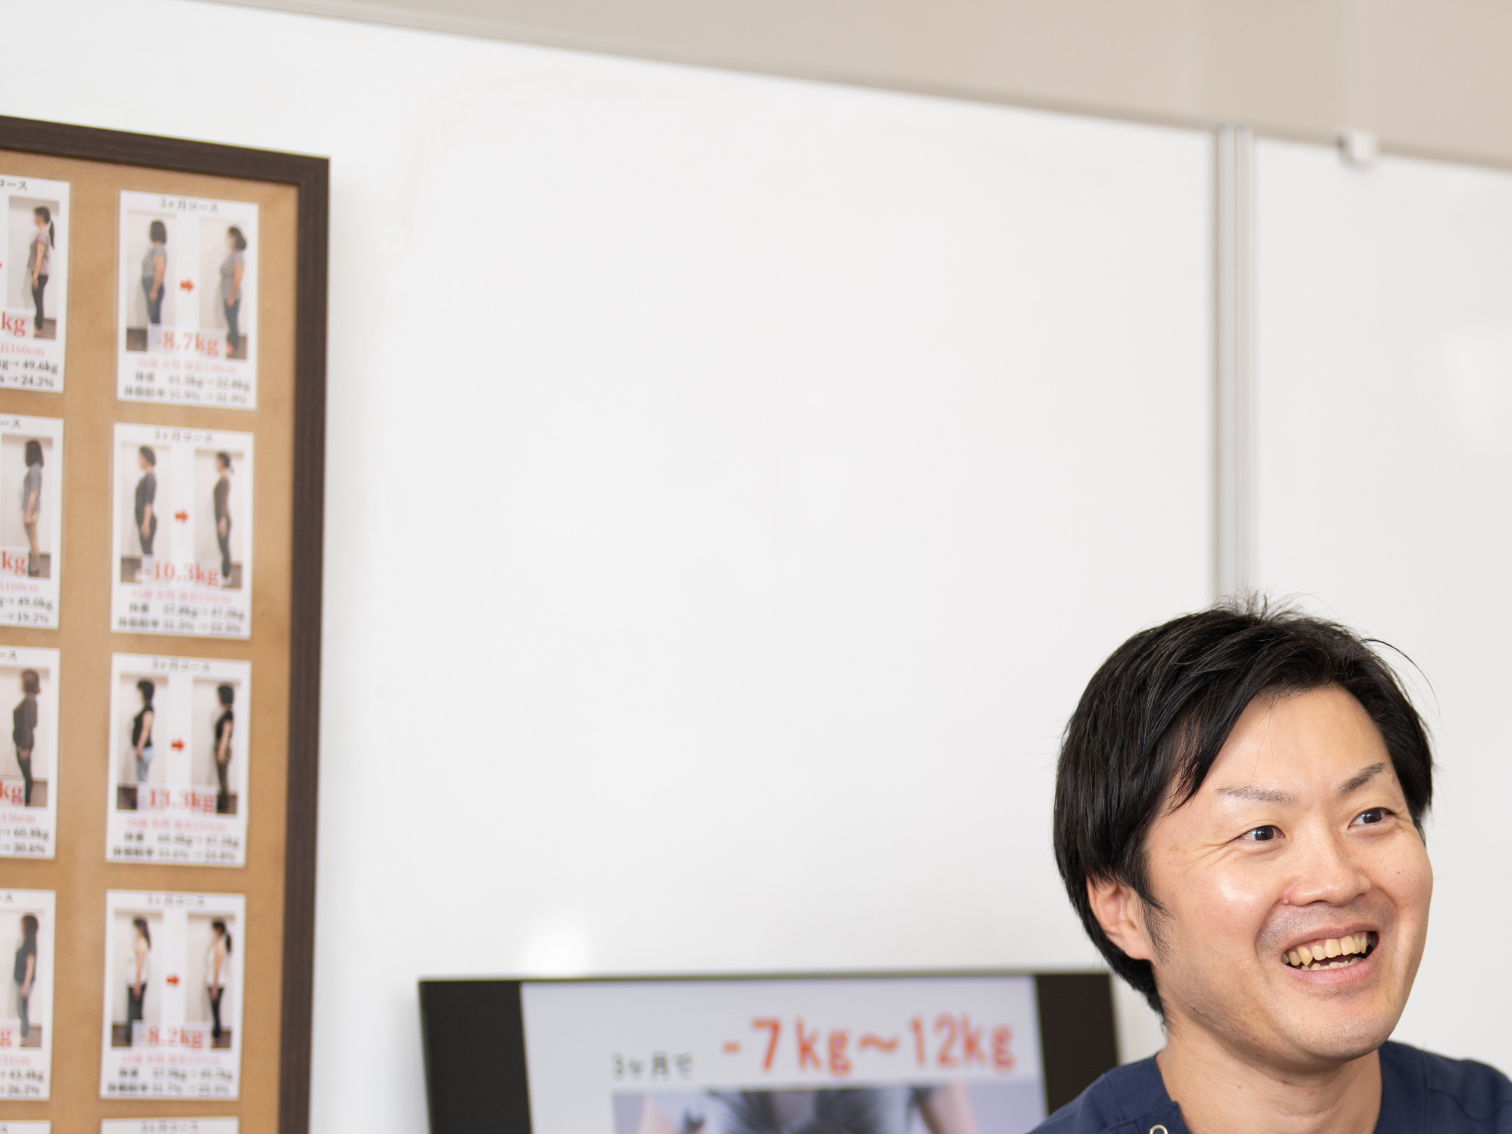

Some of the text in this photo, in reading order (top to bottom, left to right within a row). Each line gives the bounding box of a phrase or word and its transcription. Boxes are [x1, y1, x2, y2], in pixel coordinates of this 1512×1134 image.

[2, 311, 26, 337] kg
[156, 331, 219, 358] -8.7kg
[22, 359, 58, 374] 49.6kg
[21, 374, 54, 387] 24.2%
[2, 550, 26, 577] kg
[144, 561, 219, 588] -10.3kg
[0, 780, 24, 806] kg
[140, 789, 215, 815] -13.3kg
[141, 1026, 203, 1052] -8.2kg
[611, 1051, 694, 1080] 3ヶ月で
